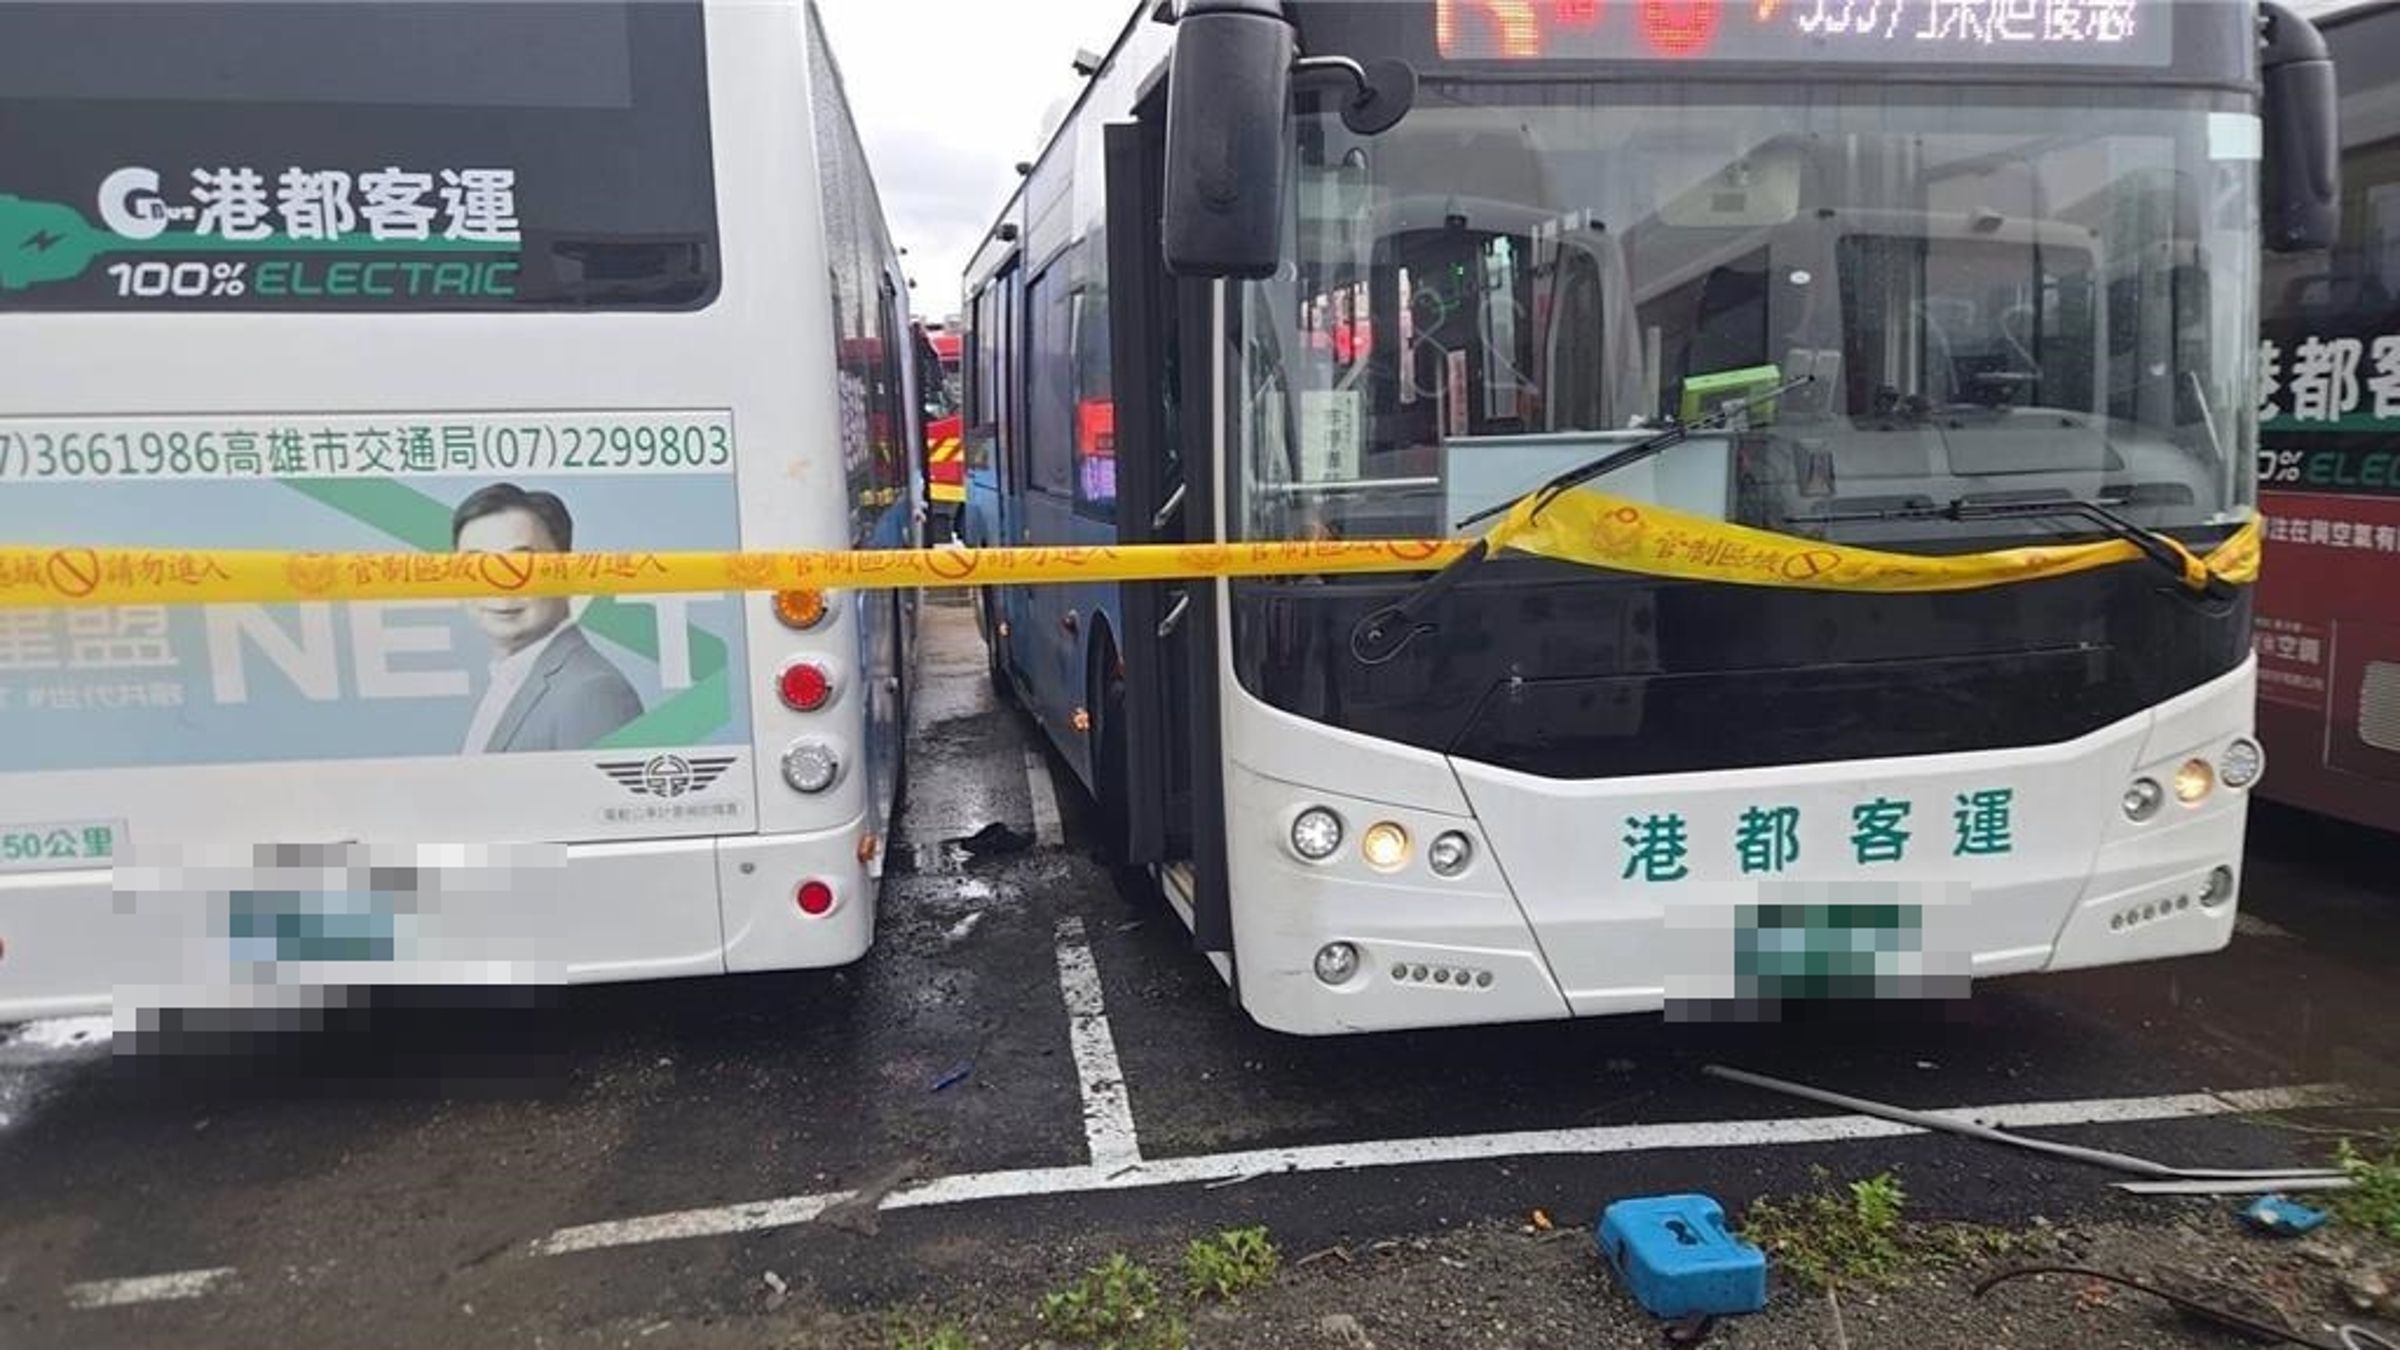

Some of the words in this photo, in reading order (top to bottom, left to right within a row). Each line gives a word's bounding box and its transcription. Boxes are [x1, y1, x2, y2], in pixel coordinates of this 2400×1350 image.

[190, 166, 522, 242] 港都客運
[107, 261, 246, 297] 100%
[254, 261, 520, 295] ELECTRIC
[1622, 787, 2014, 883] 港都客運
